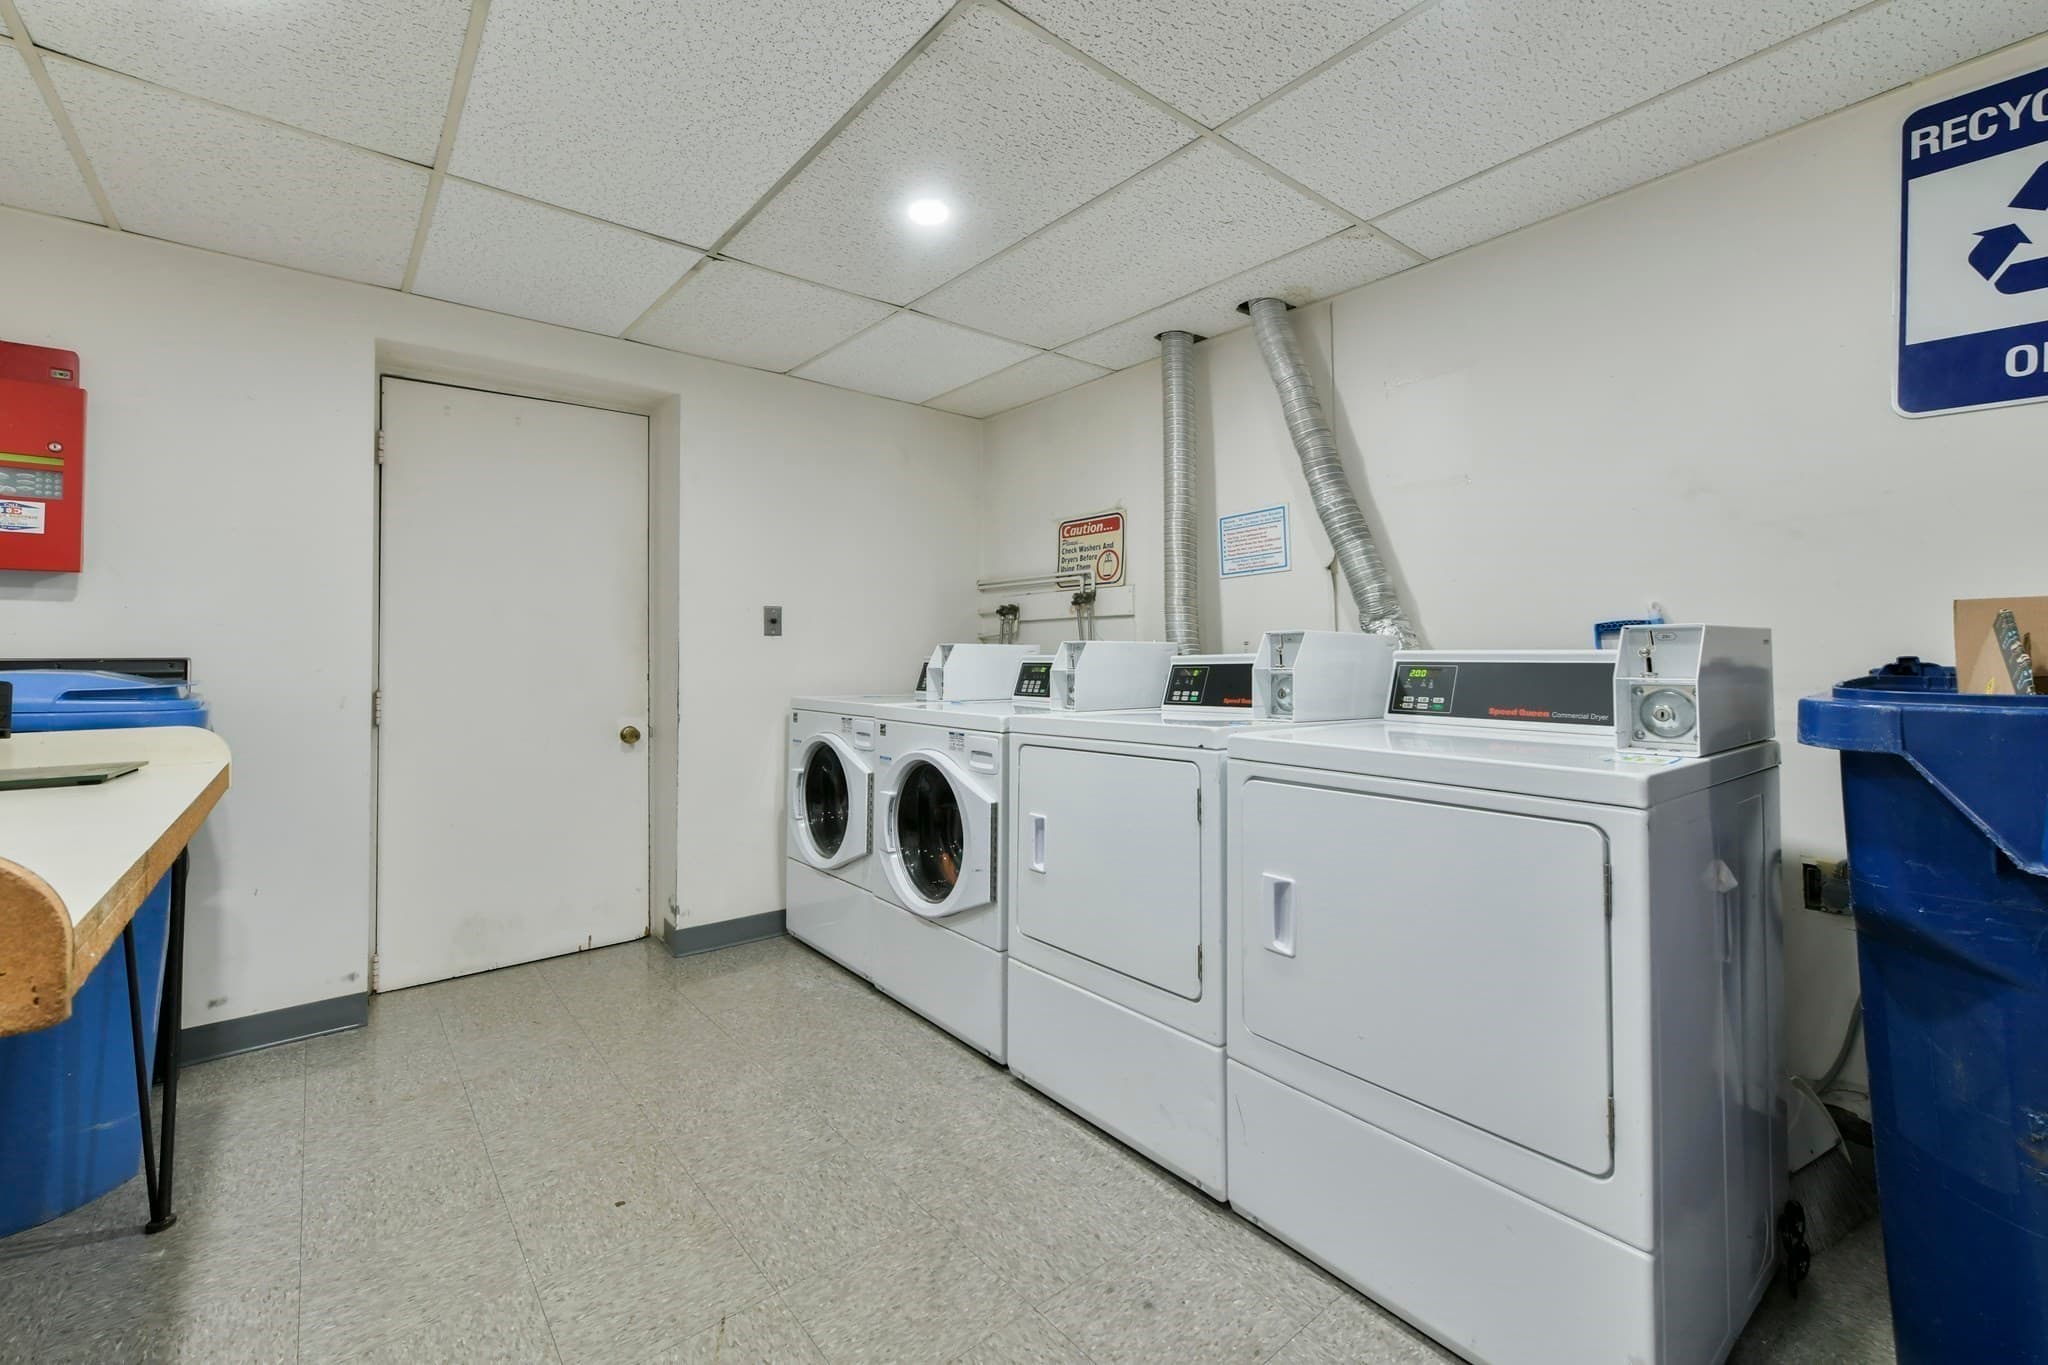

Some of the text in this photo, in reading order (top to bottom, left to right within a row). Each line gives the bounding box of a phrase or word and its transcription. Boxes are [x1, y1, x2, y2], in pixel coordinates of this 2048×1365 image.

[2005, 341, 2048, 377] O
[1063, 522, 1113, 537] Caution...
[1061, 541, 1115, 555] Check Washers And
[1061, 554, 1098, 565] Dryers Before
[1488, 707, 1609, 722] Speed Queen Commercial Dryer
